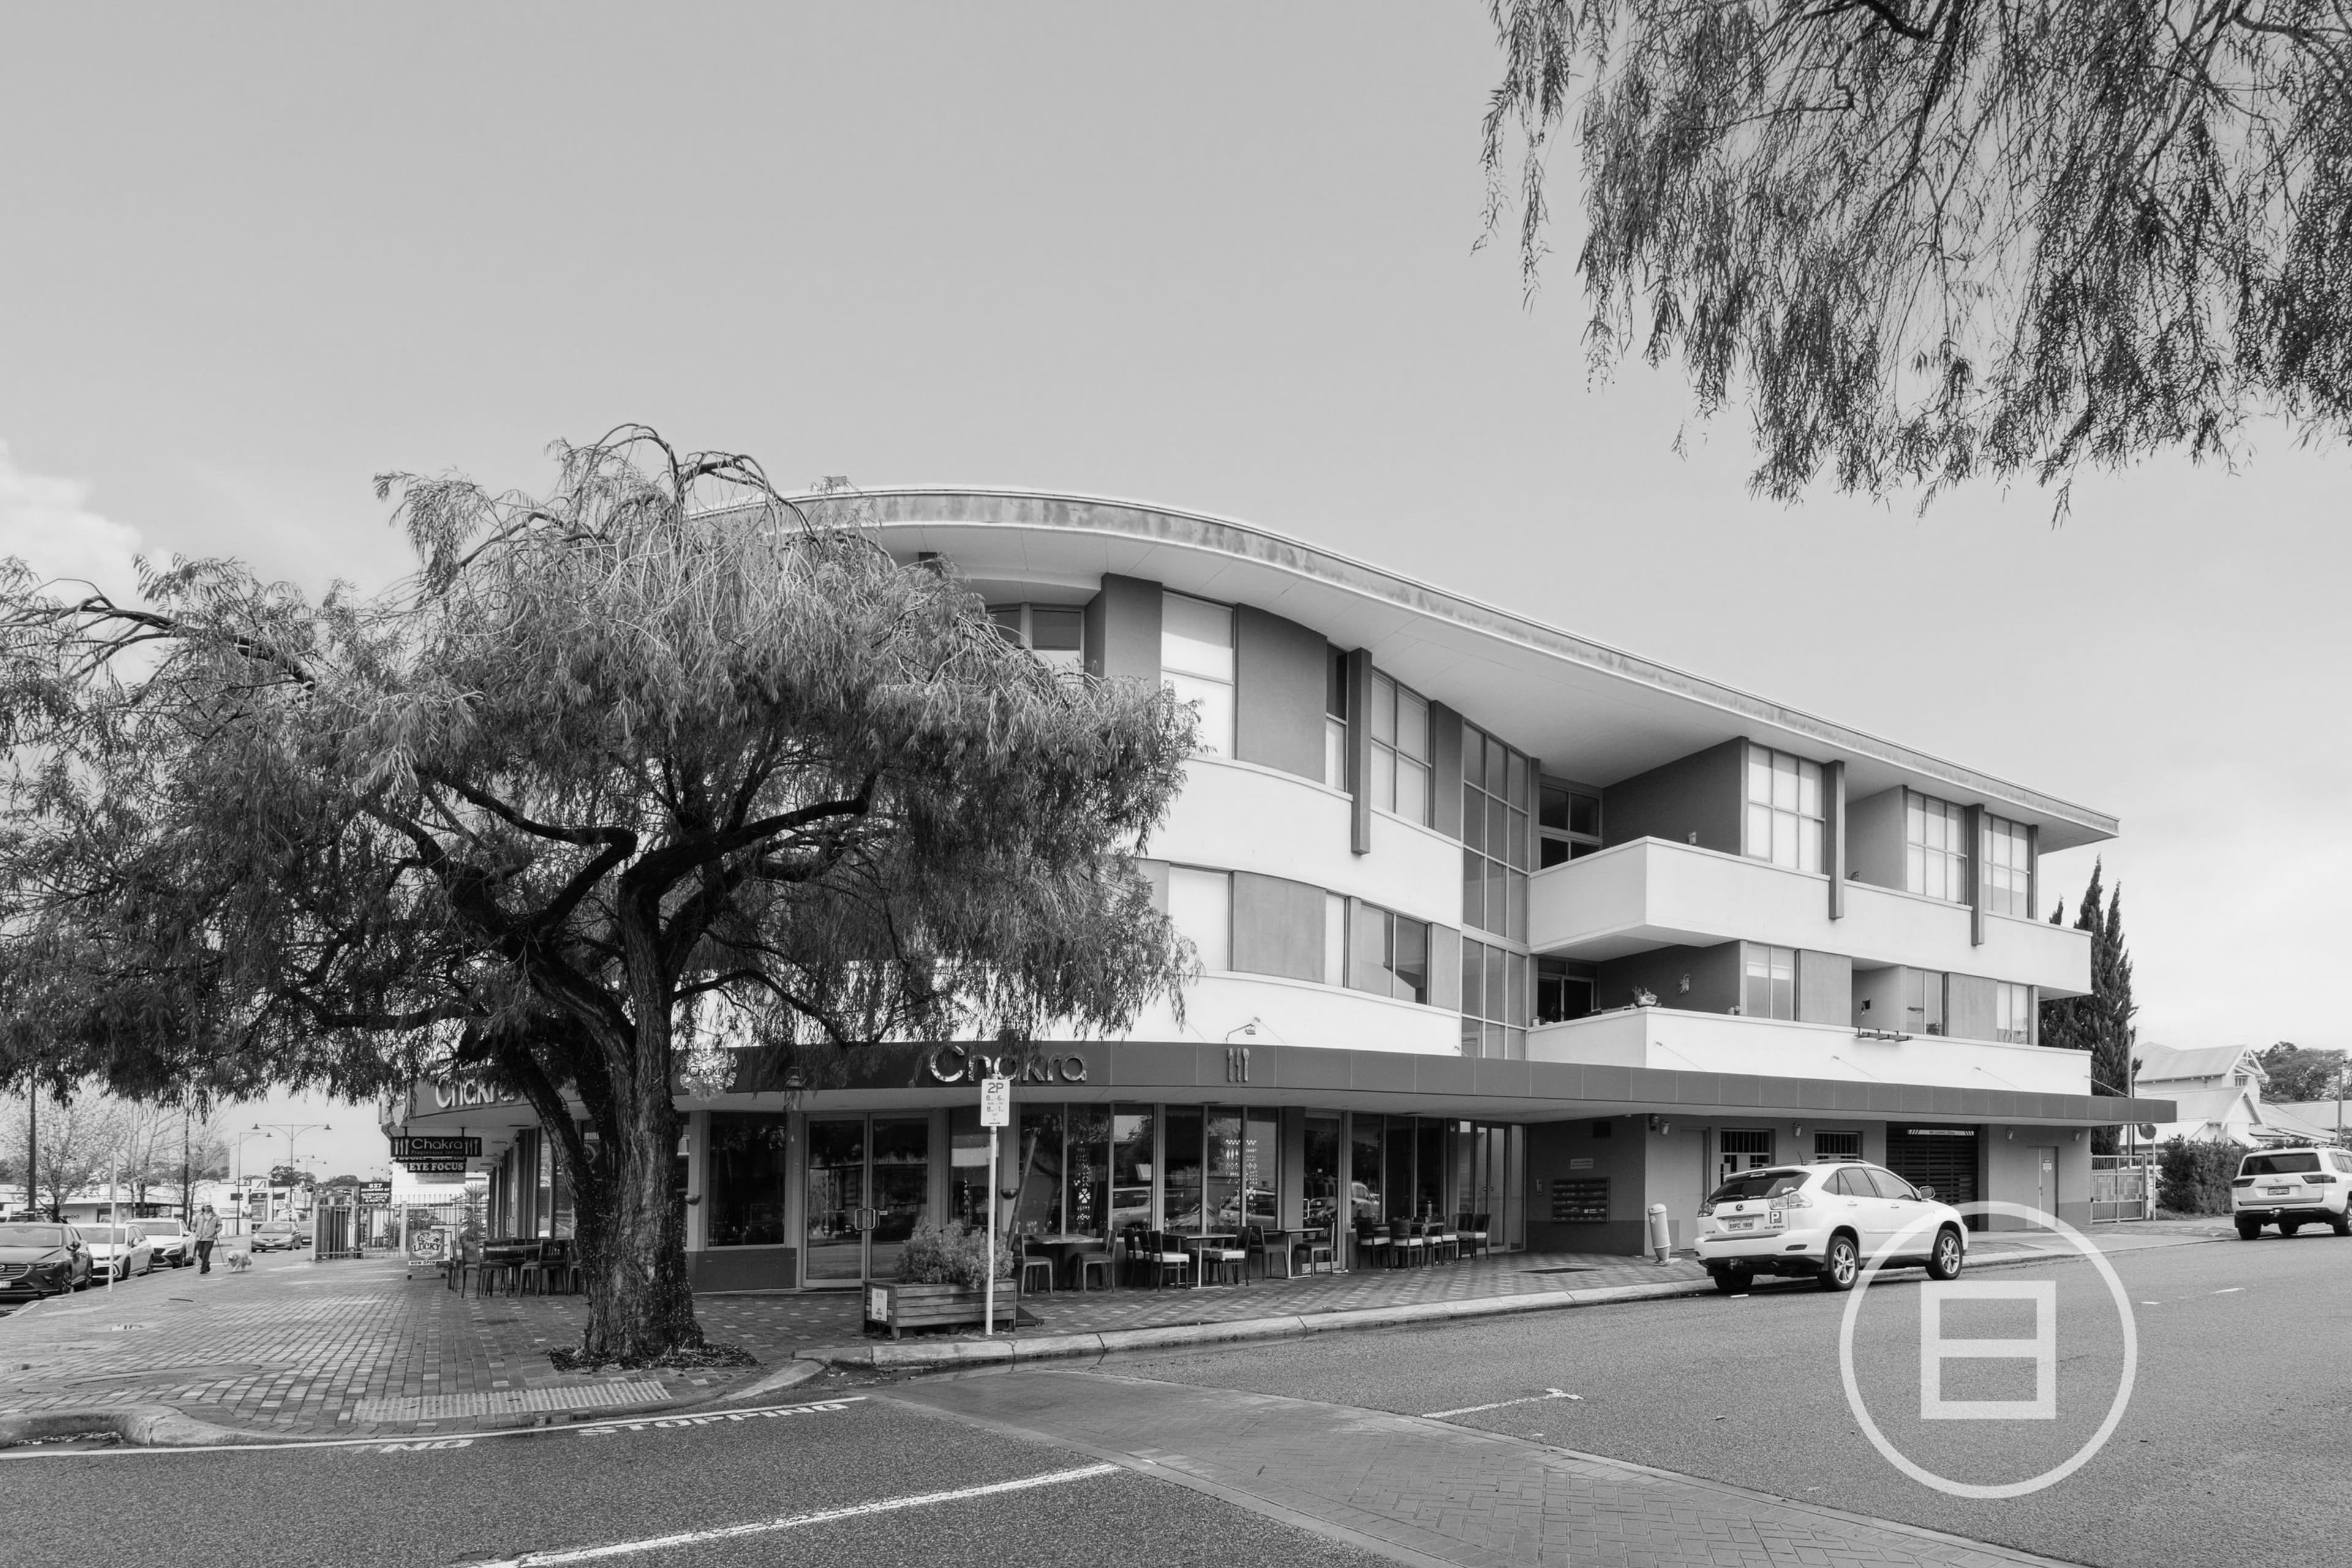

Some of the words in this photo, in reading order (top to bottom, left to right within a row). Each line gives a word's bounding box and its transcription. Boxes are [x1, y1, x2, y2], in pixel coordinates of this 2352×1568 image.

[987, 1082, 1004, 1093] 2P
[411, 1138, 463, 1150] Chakra
[409, 1163, 429, 1171] EYE
[431, 1163, 464, 1171] FOCUS
[578, 1403, 849, 1436] STOPPING
